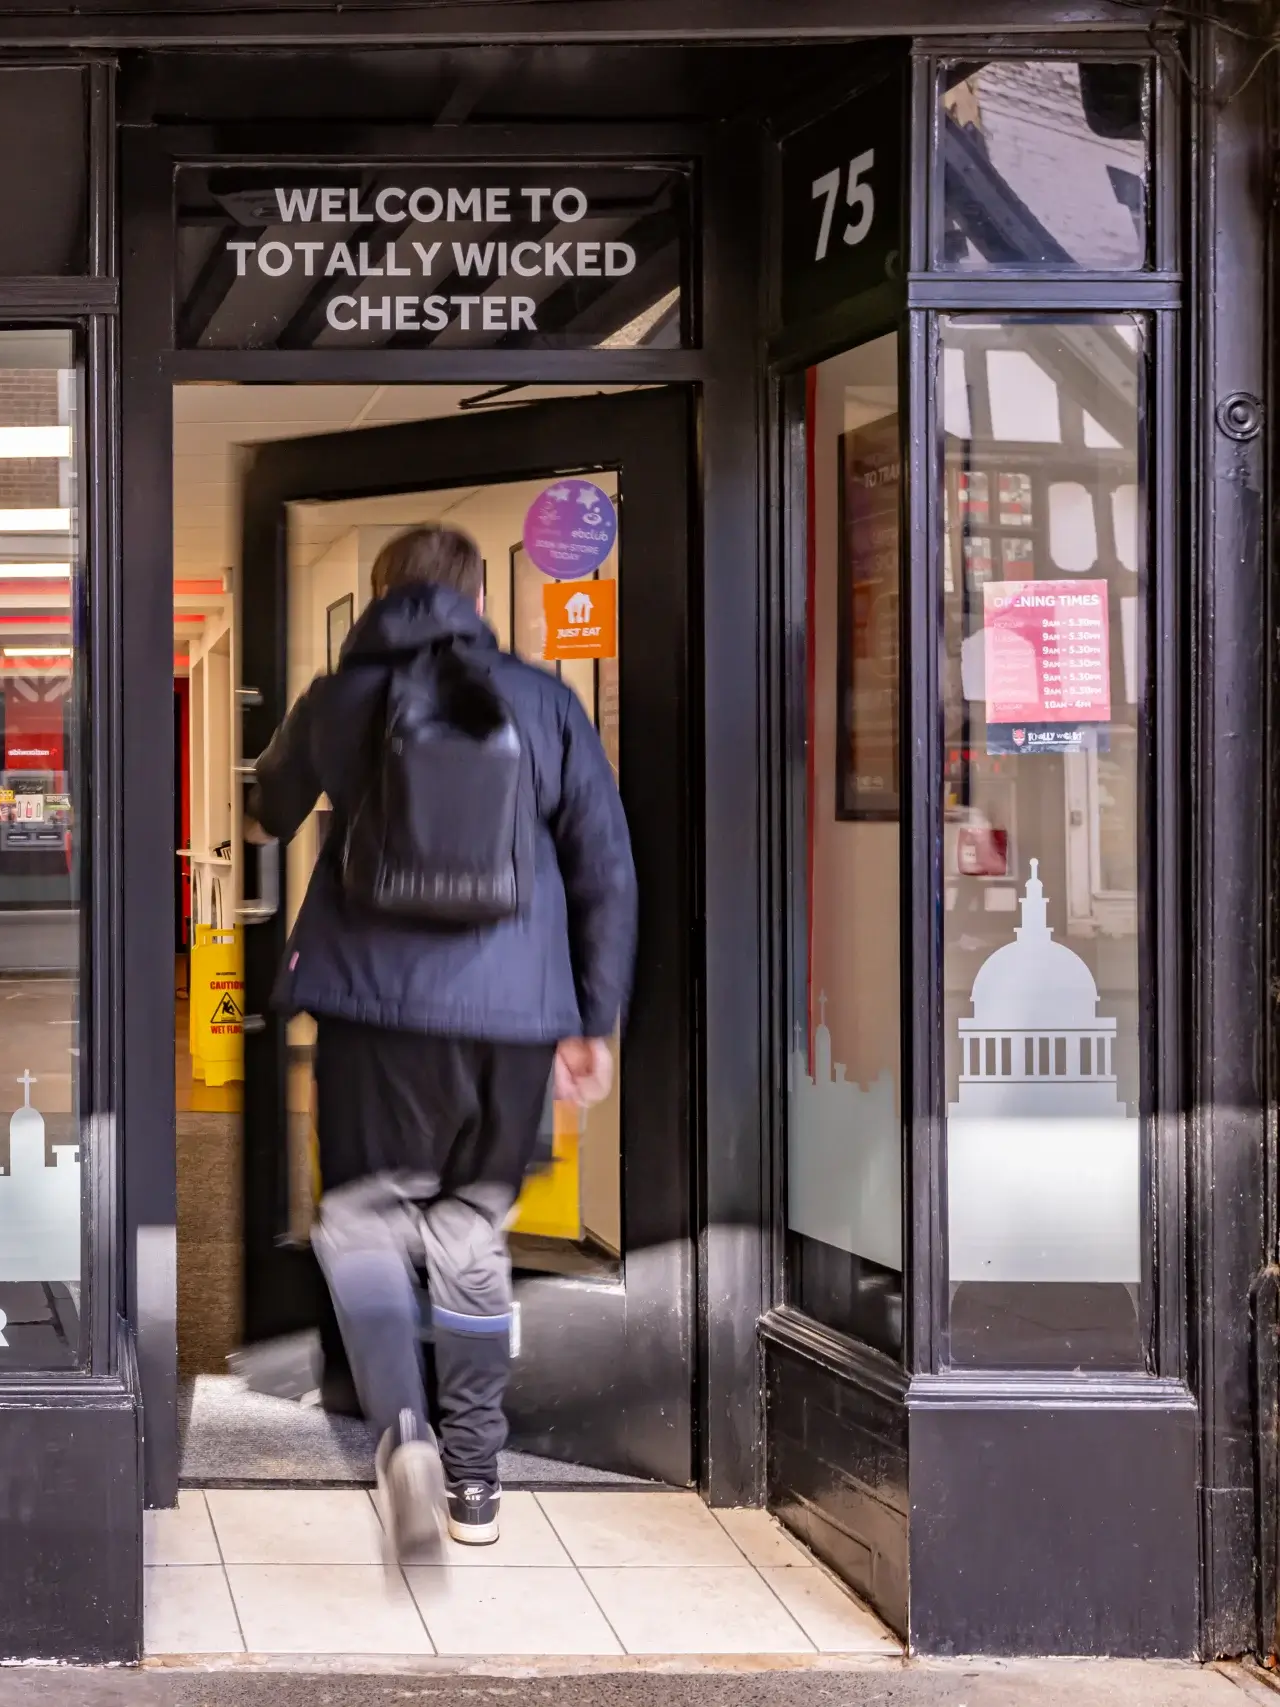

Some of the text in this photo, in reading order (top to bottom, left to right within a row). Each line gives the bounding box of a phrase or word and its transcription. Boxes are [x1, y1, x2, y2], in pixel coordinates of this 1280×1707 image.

[274, 187, 588, 223] WELCOME TO
[812, 148, 874, 261] 75
[226, 241, 637, 277] TOTALLY WICKED
[325, 295, 538, 331] CHESTER
[1058, 594, 1100, 606] TIMES
[556, 626, 601, 639] JUST EAT
[211, 1025, 225, 1034] WET
